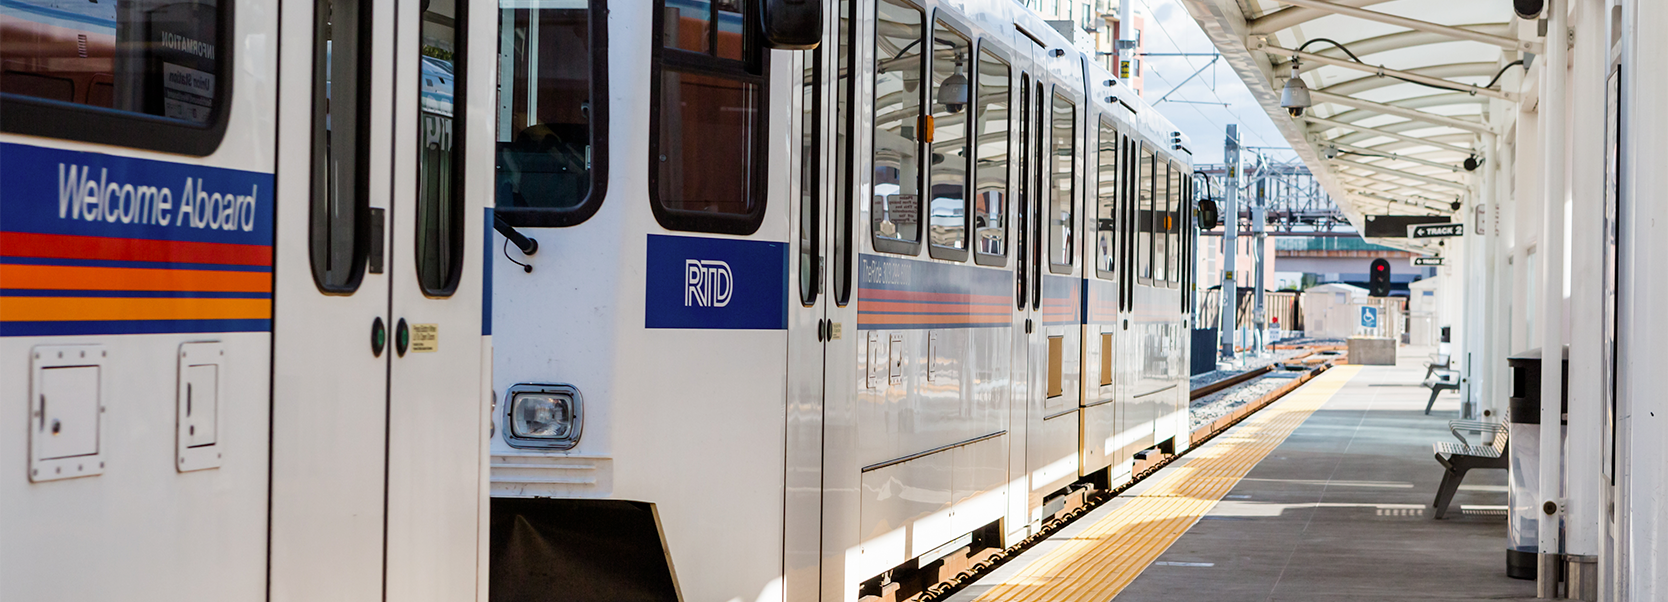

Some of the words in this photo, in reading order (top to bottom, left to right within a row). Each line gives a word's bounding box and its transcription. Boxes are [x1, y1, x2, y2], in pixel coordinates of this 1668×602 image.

[58, 163, 172, 226] Welcome
[176, 177, 258, 232] Aboard
[1426, 227, 1453, 235] TRACK
[1455, 225, 1463, 235] 2
[684, 259, 734, 307] RTD
